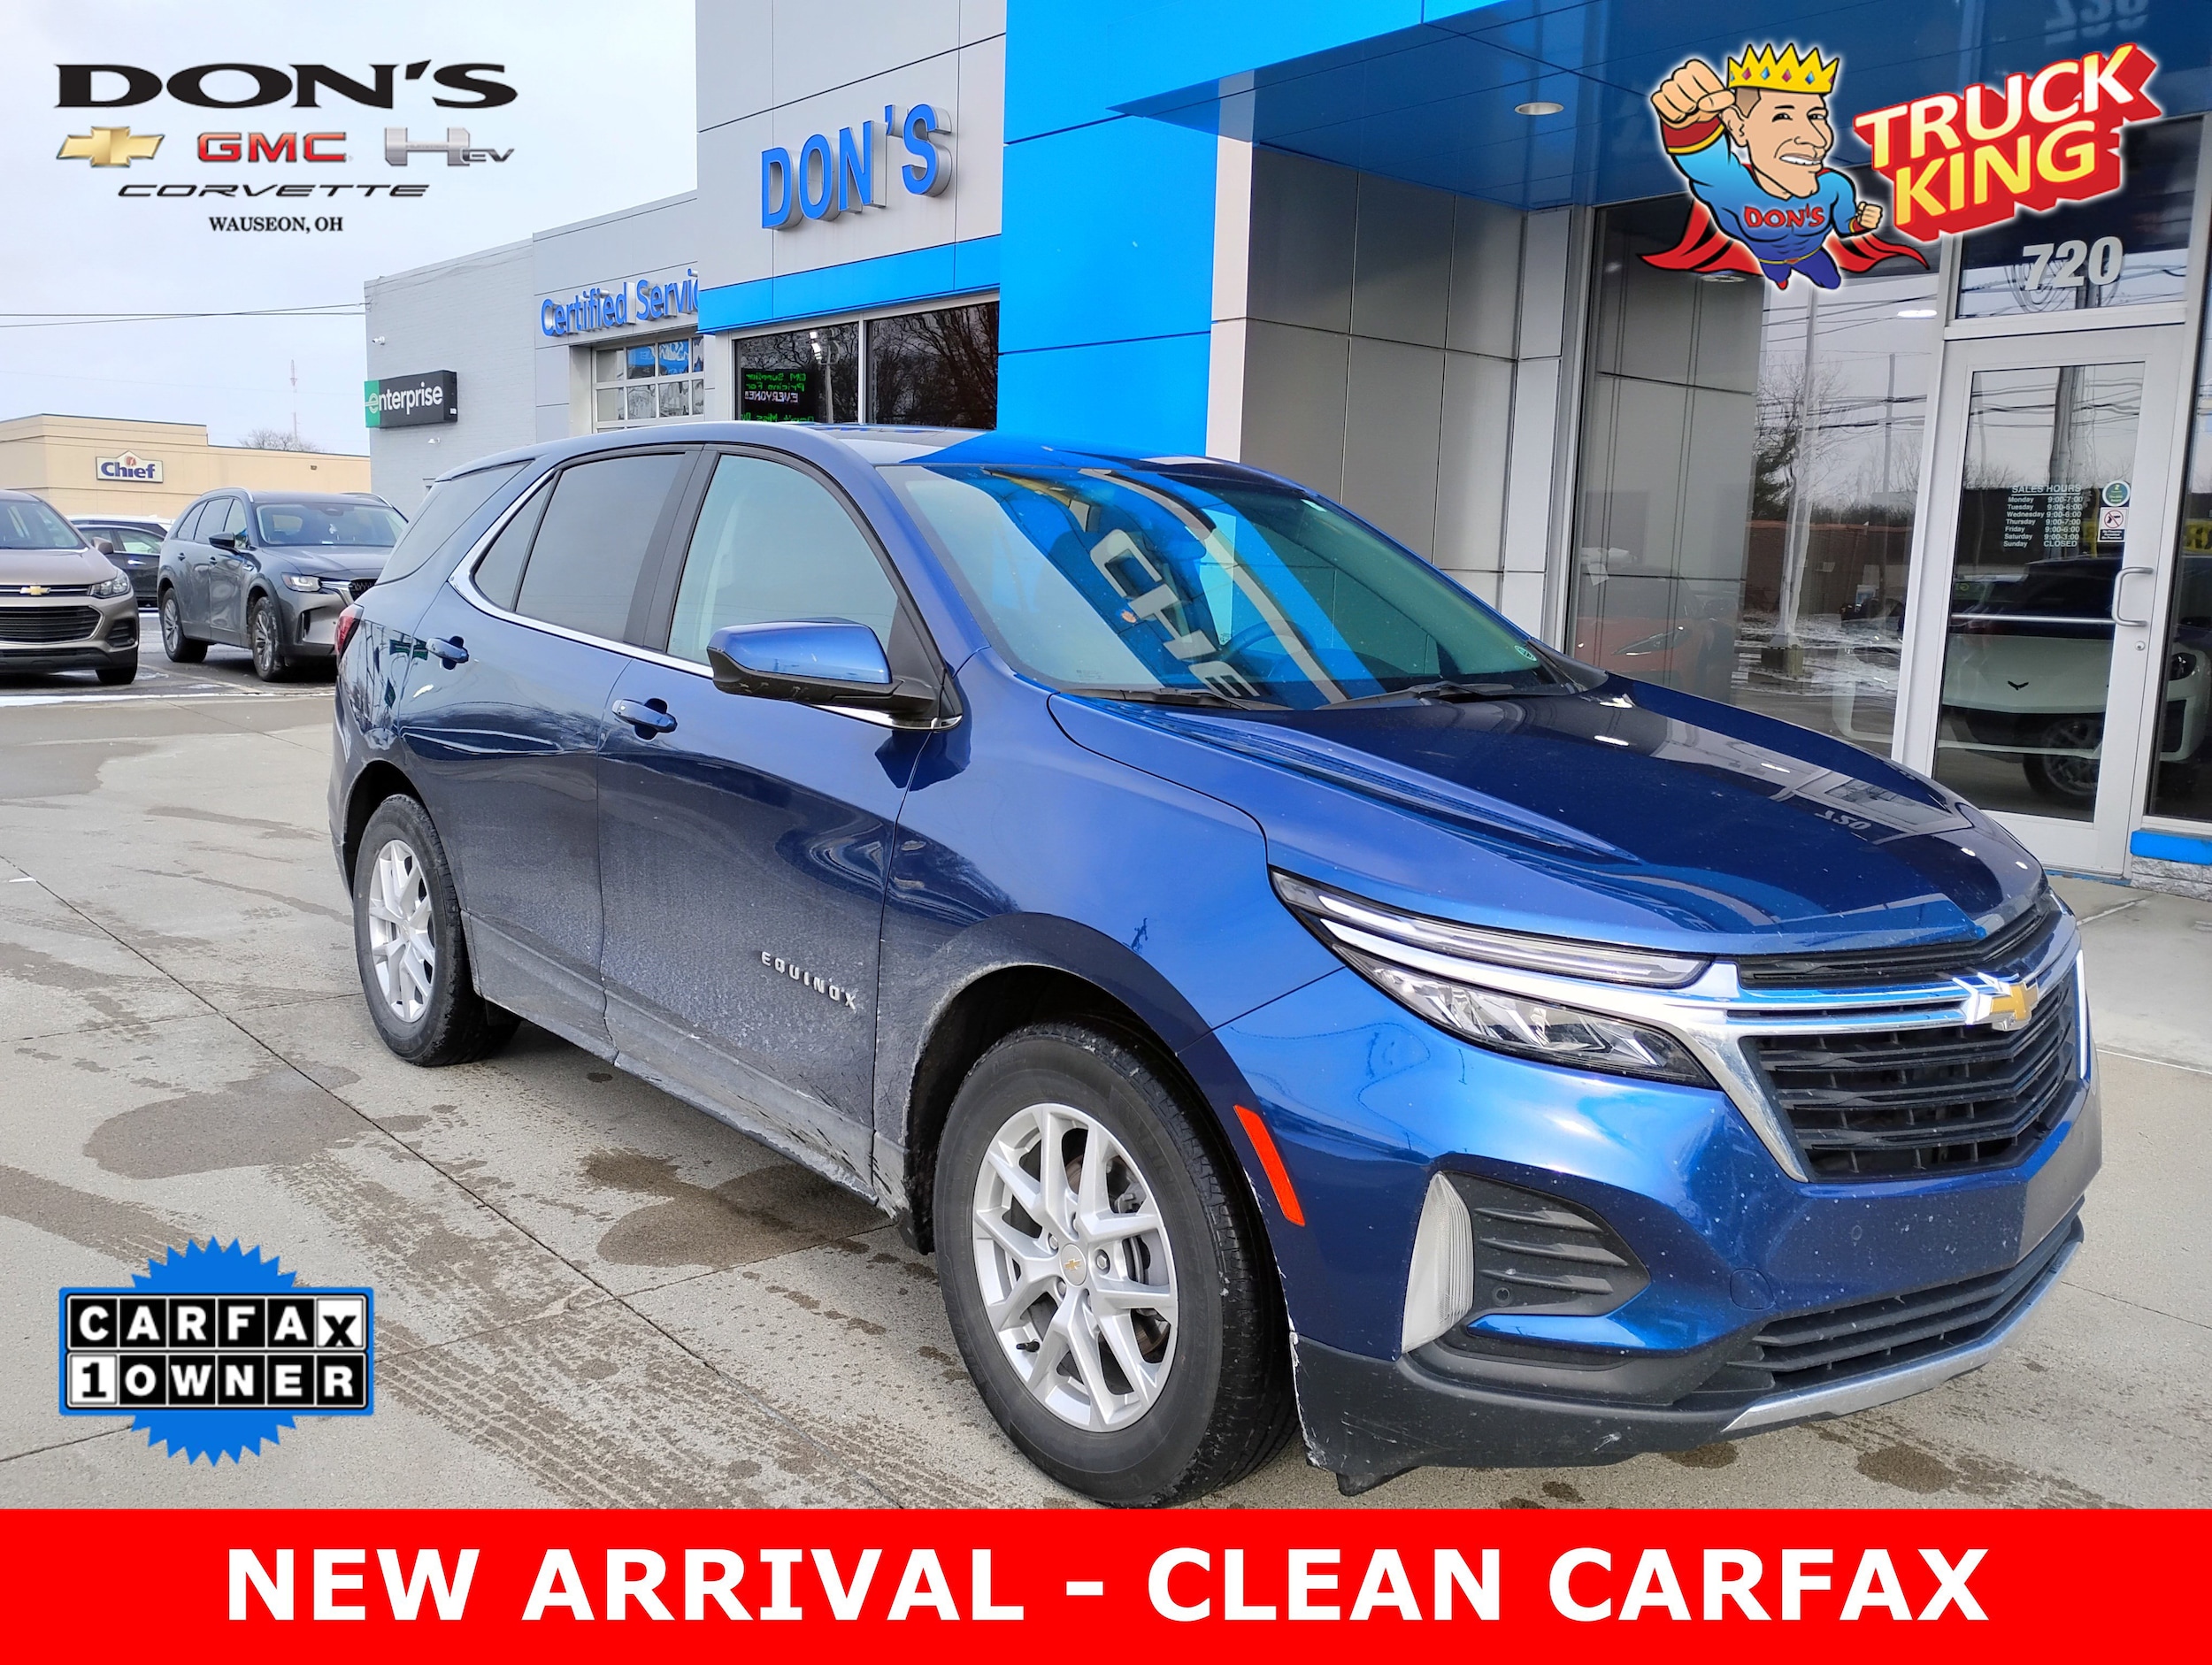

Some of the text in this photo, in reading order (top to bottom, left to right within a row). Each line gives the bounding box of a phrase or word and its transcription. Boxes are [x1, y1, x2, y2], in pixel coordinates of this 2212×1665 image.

[761, 103, 952, 231] DON'S
[2022, 235, 2124, 292] 720
[541, 281, 631, 337] Certified
[365, 381, 443, 416] enterprise
[101, 461, 156, 479] Chief
[2011, 484, 2082, 494] SALES HOURS
[761, 951, 857, 1014] EQUINOX
